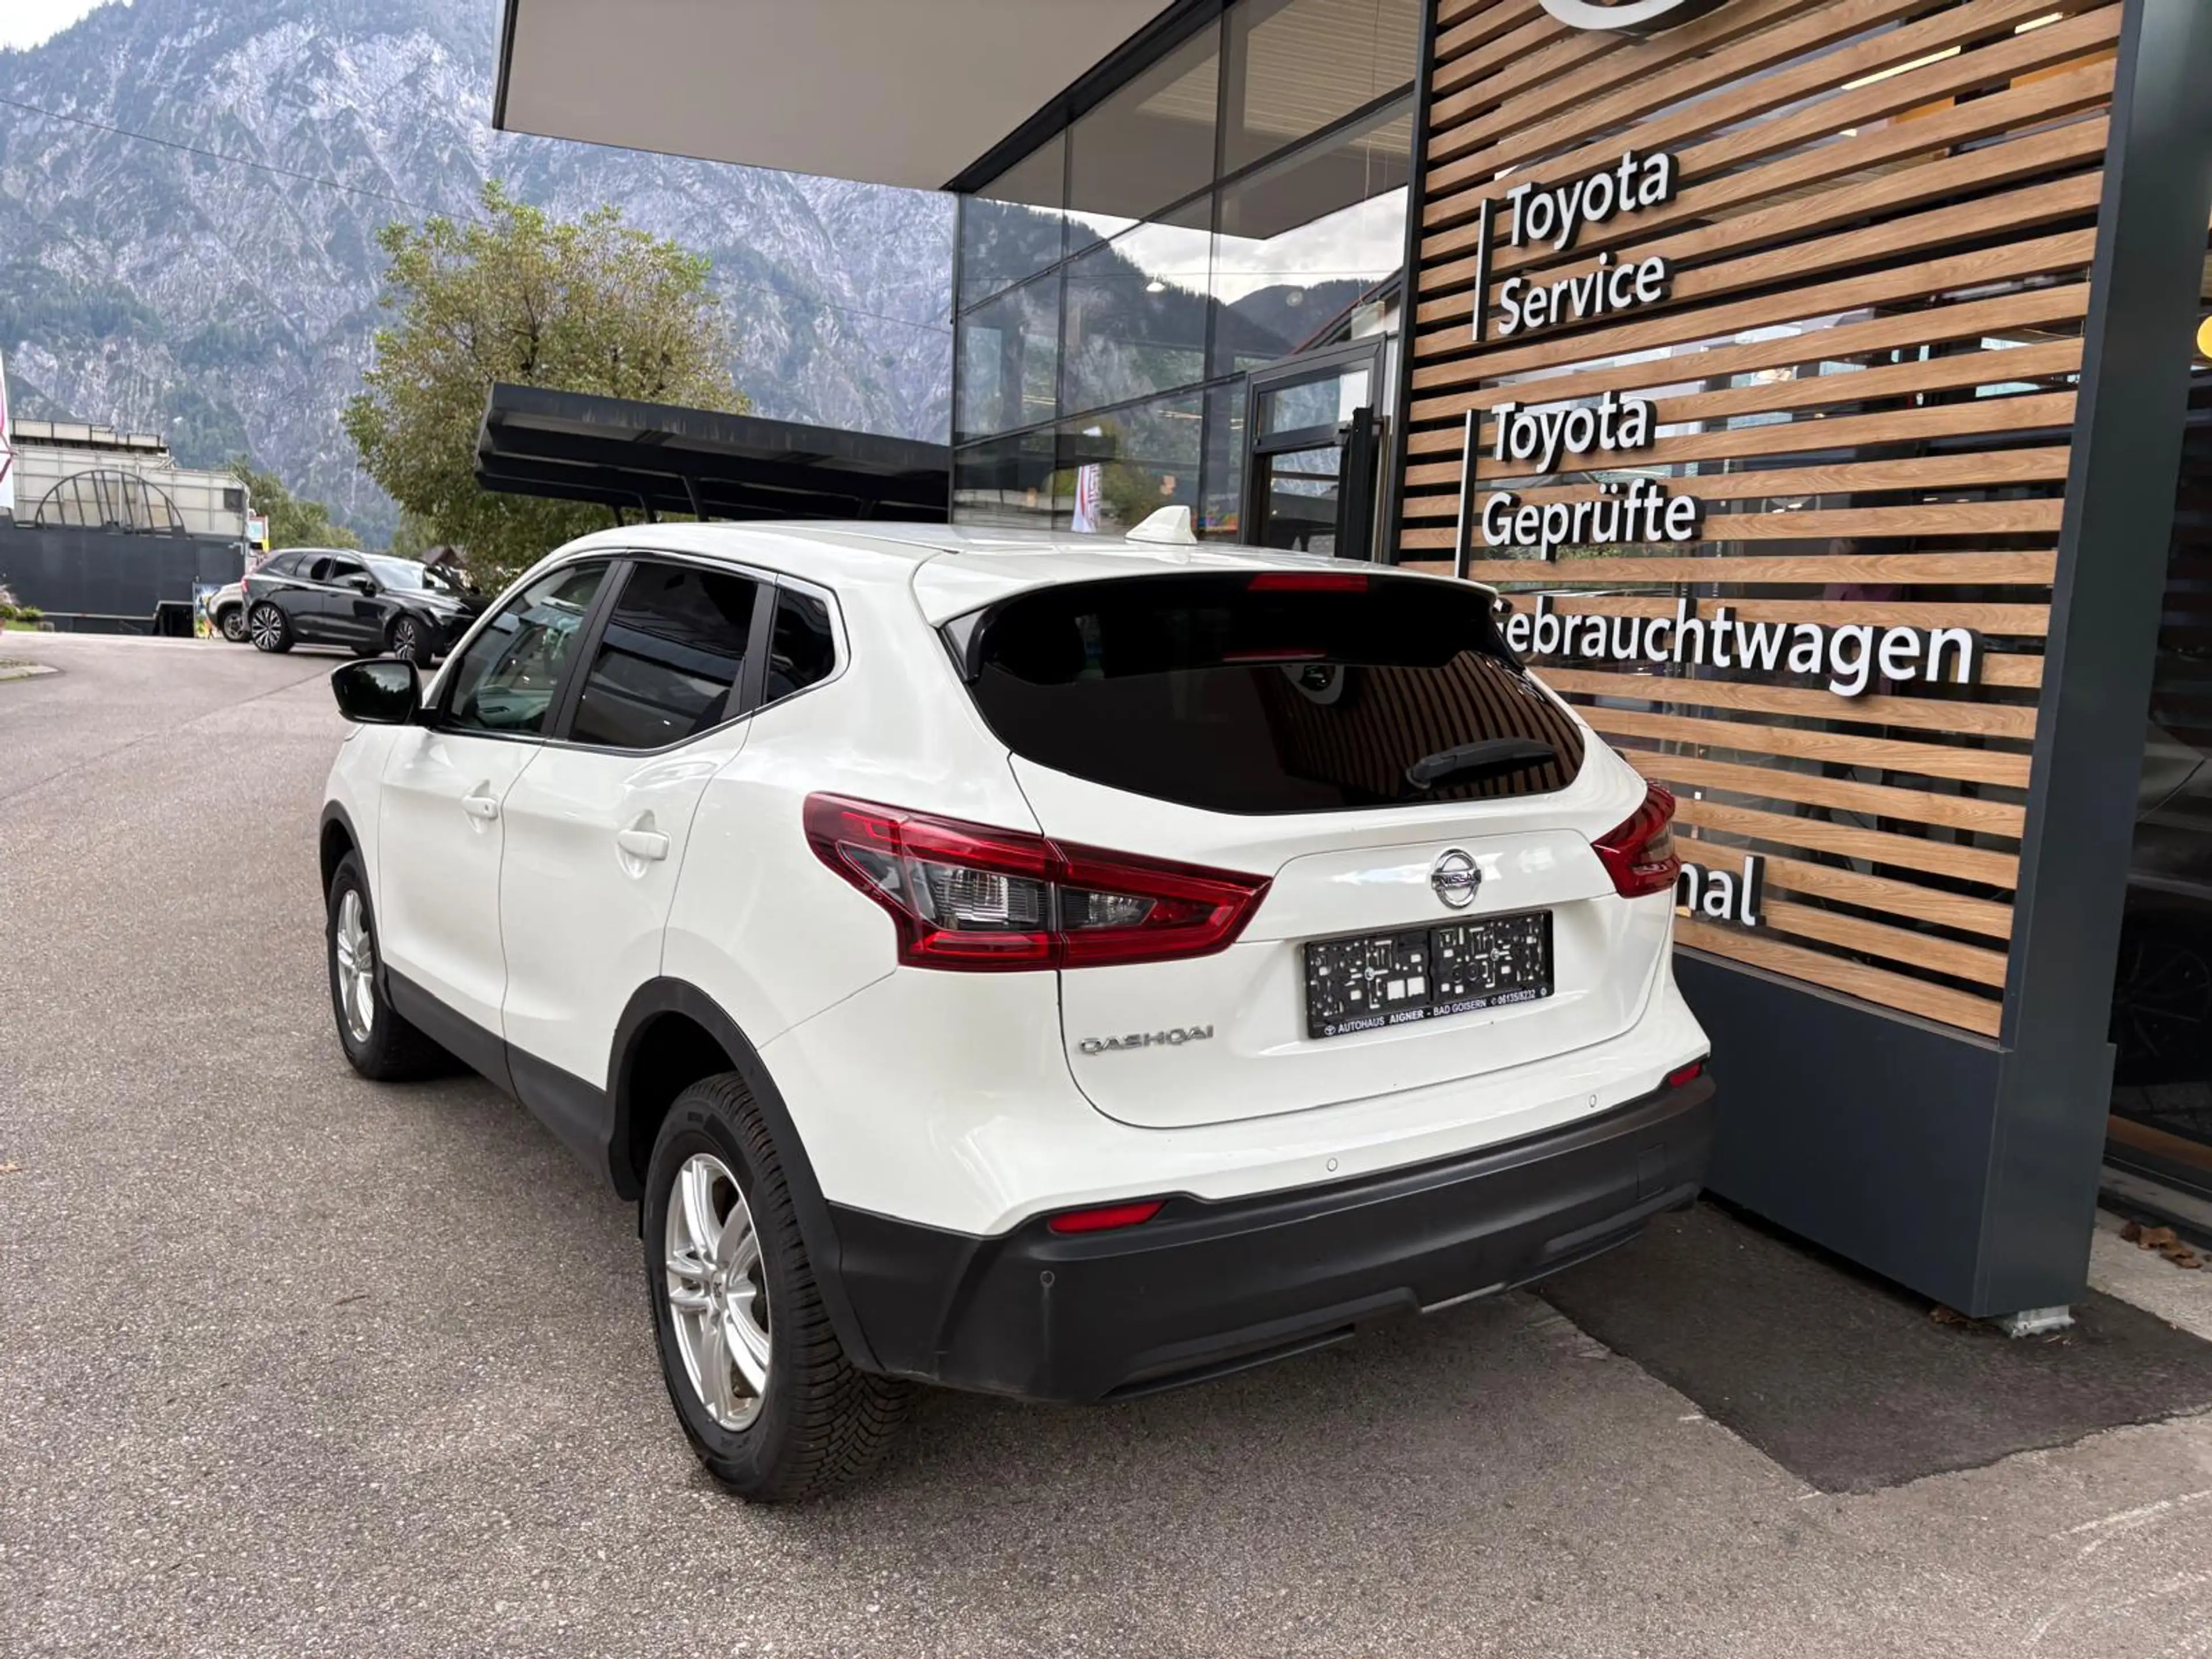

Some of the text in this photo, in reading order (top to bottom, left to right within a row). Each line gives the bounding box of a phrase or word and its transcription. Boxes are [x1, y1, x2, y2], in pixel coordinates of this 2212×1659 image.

[1507, 150, 1669, 250] Toyota
[1498, 252, 1665, 334] Service
[1491, 391, 1647, 474] Toyota
[1482, 478, 1696, 561] Geprüfte
[1079, 1024, 1214, 1055] QASHQAI
[1338, 1016, 1385, 1034] AUTOHAUS
[1389, 1009, 1425, 1024] AIGNER
[1433, 1006, 1450, 1016] BAD
[1452, 998, 1487, 1013] GOISERN
